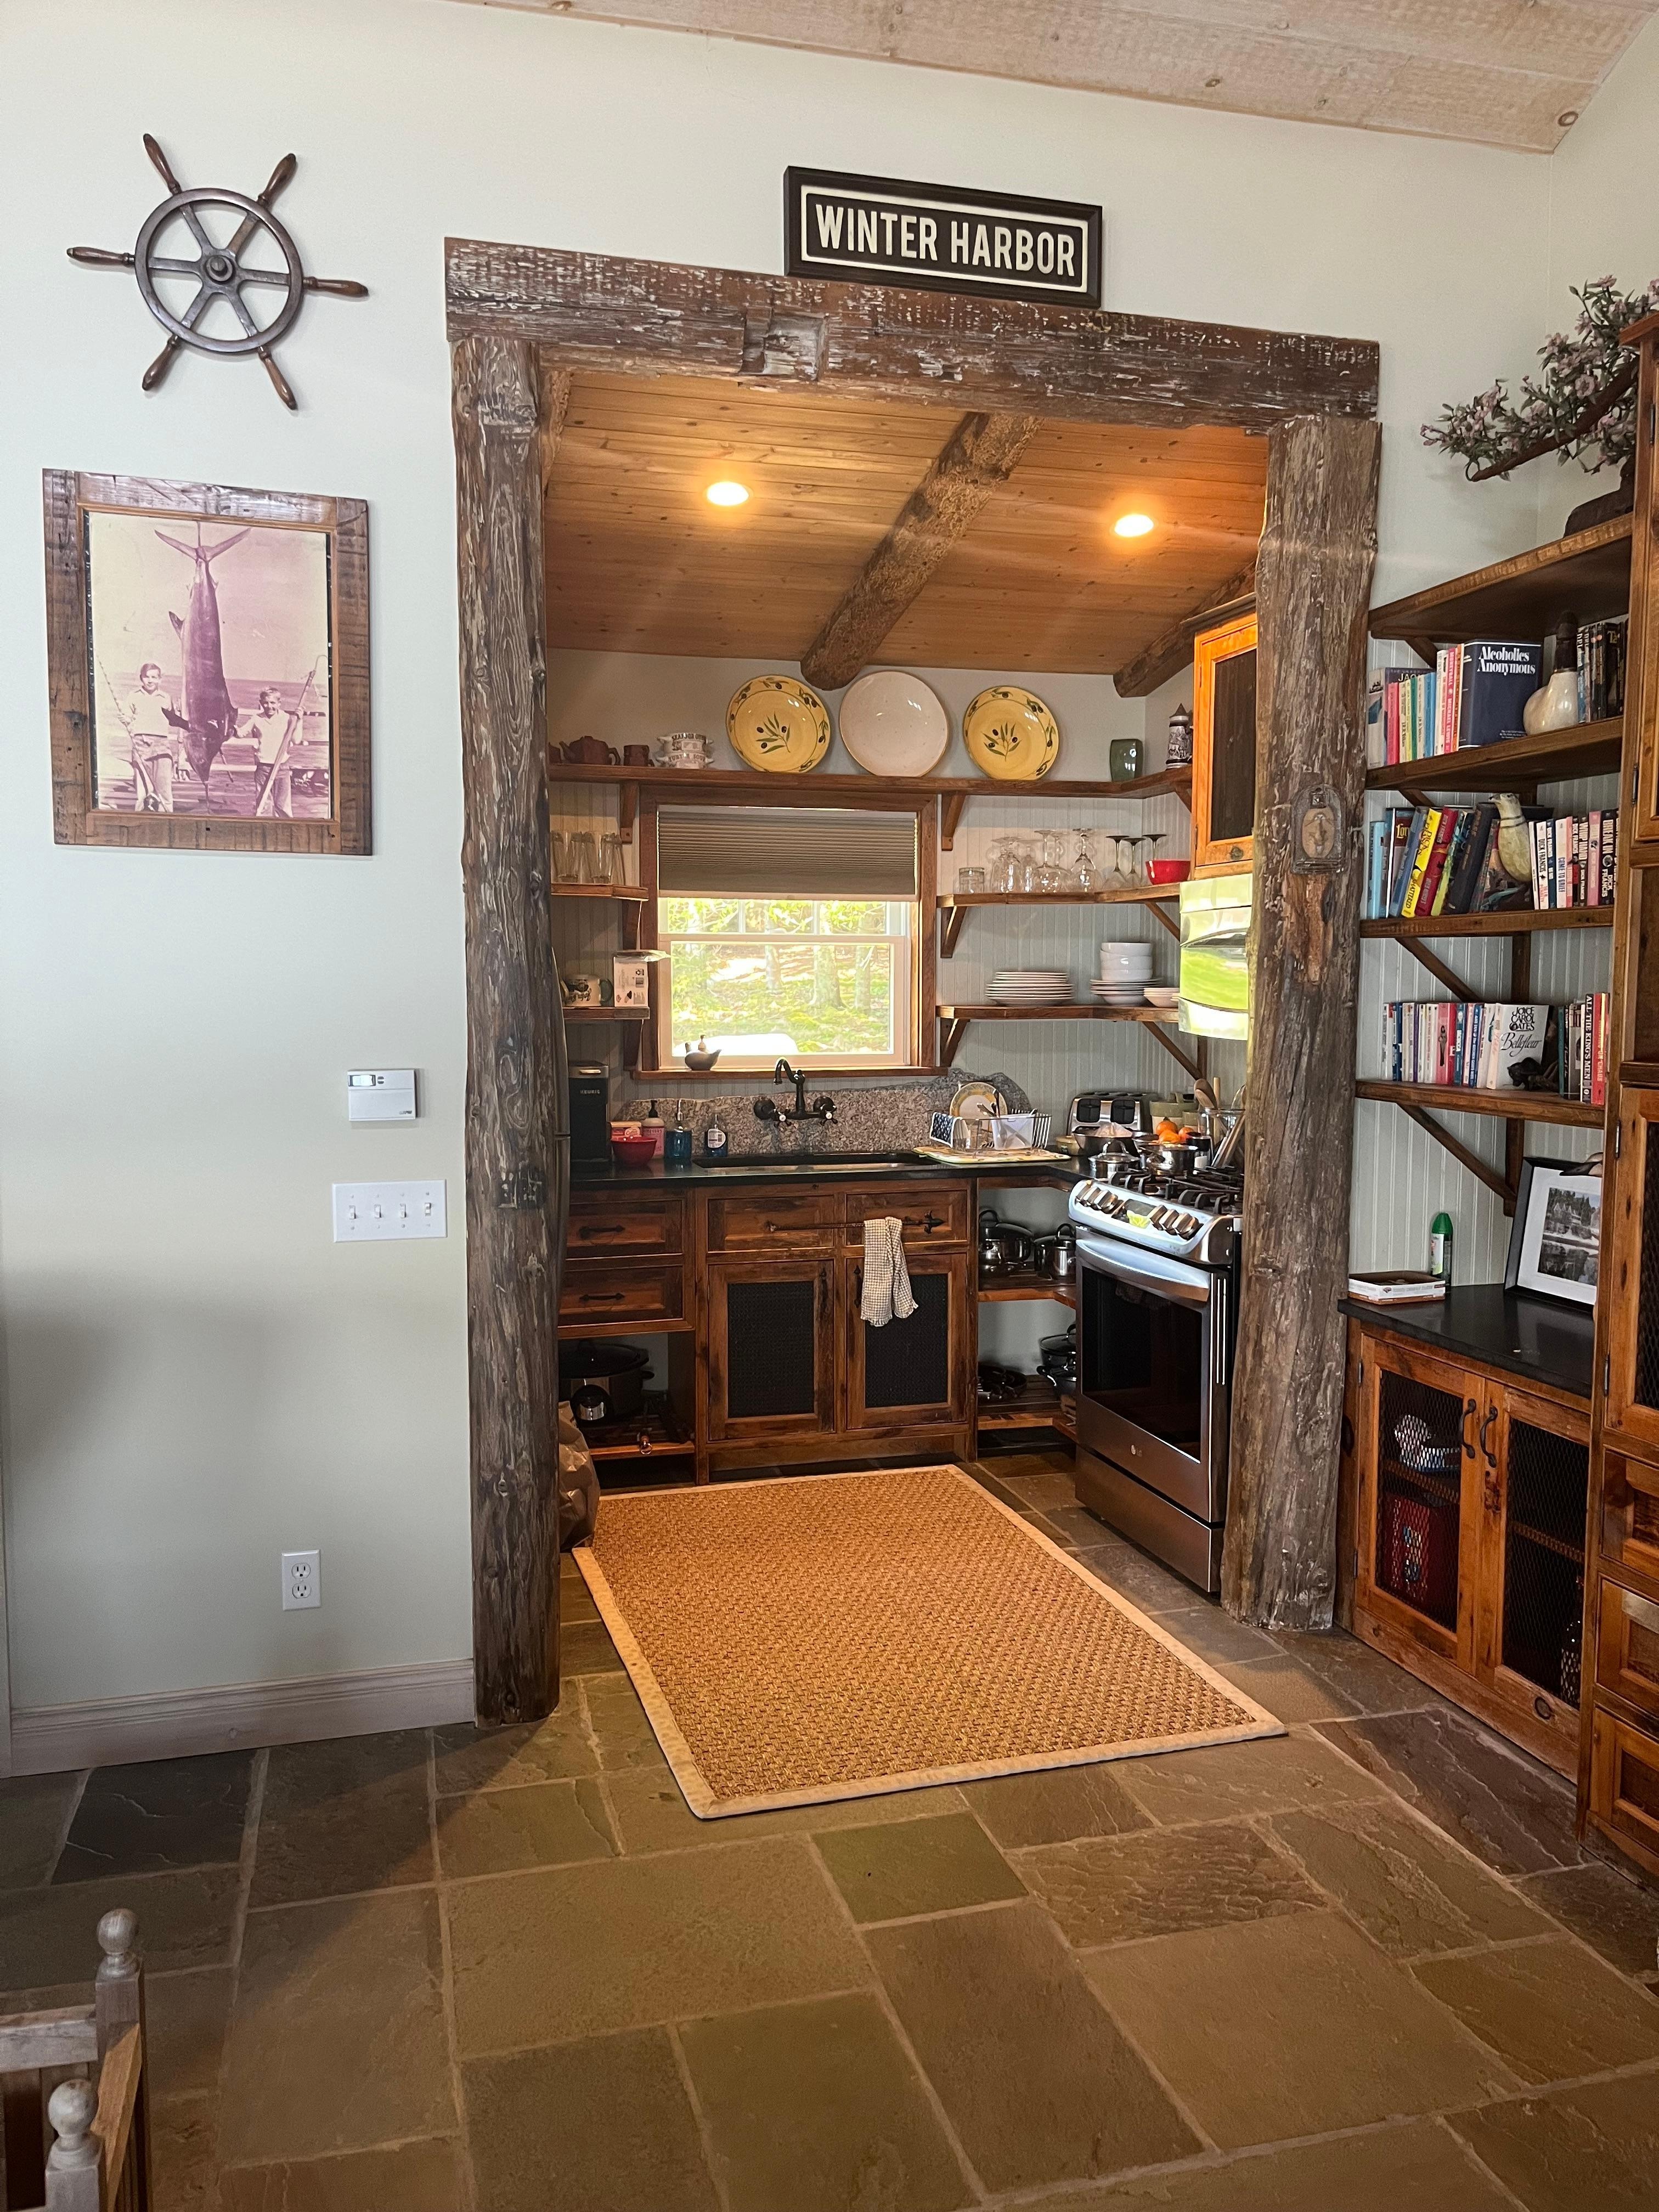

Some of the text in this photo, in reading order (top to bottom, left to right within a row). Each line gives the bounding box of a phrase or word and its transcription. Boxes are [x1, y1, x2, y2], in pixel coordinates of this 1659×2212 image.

[815, 204, 1075, 276] WINTER HARBOR
[1479, 646, 1530, 662] Alcoholics
[1477, 658, 1536, 675] Anonymous
[669, 754, 690, 762] TURTE
[1579, 822, 1588, 840] WHIP
[1602, 820, 1613, 854] BREAK IN
[1579, 842, 1588, 860] HAND
[1406, 878, 1417, 909] SHATTERED
[1511, 1014, 1535, 1024] CAROL
[1512, 1007, 1535, 1015] JOYCE
[1509, 1022, 1534, 1031] OATES
[1500, 1032, 1542, 1057] Bellefleur
